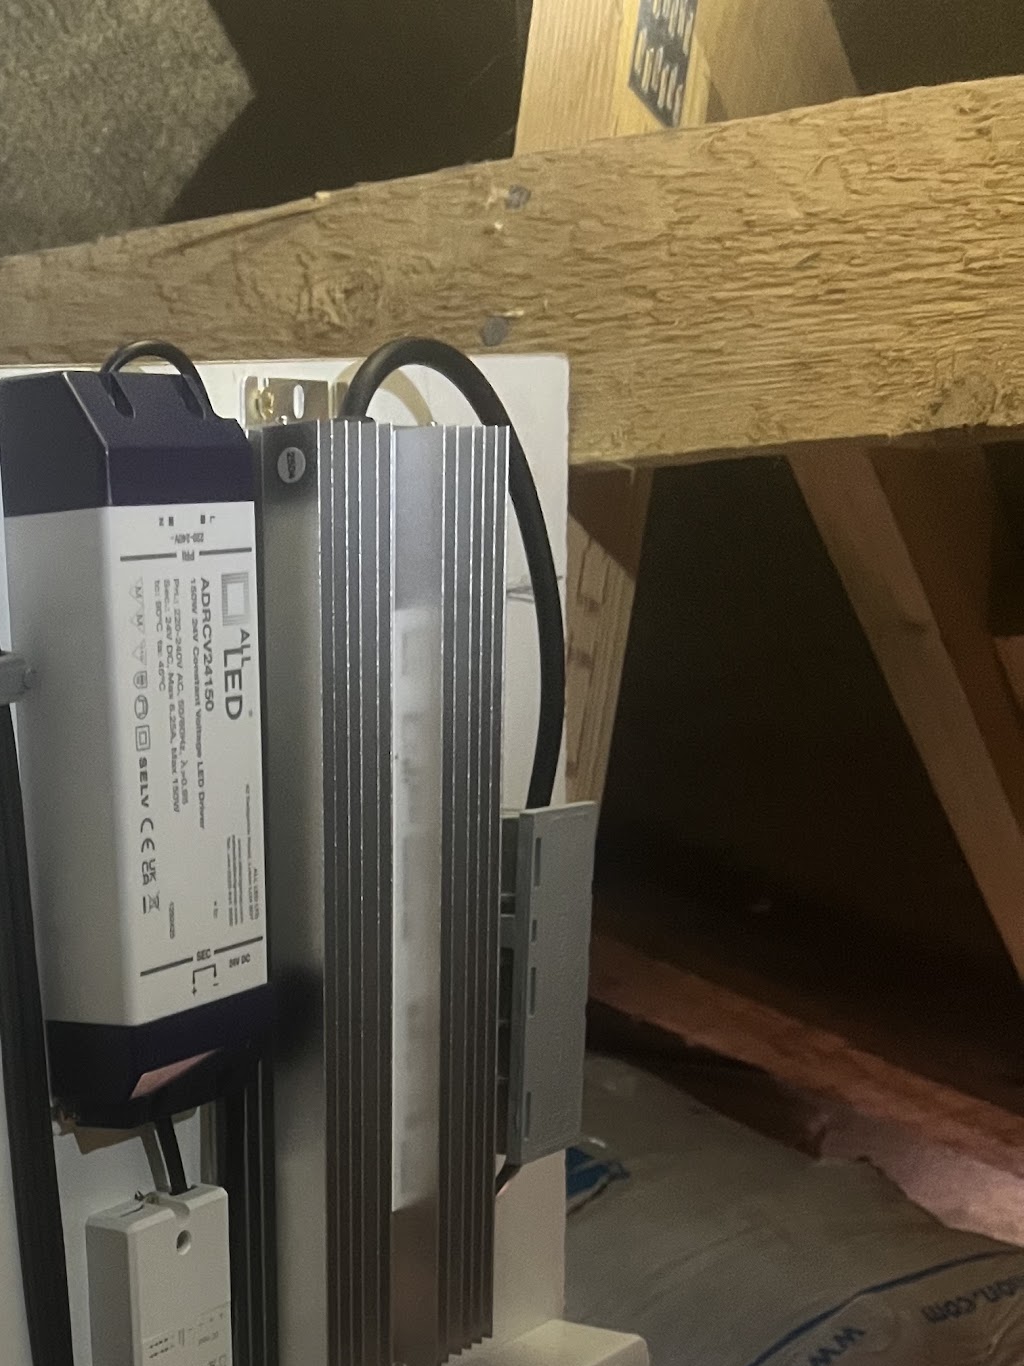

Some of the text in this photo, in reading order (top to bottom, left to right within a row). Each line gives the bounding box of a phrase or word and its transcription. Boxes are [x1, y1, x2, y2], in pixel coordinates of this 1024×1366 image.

[189, 577, 197, 614] 150W
[164, 615, 172, 640] 24V
[173, 607, 182, 668] 220-240V
[200, 576, 214, 712] ADRCV24150
[239, 628, 251, 667] ALL
[166, 672, 175, 700] Max
[192, 645, 201, 706] Constant
[223, 647, 244, 721] LED
[194, 708, 203, 758] Voltage
[169, 747, 178, 774] Max
[196, 760, 204, 788] LED
[138, 756, 148, 808] SELV
[171, 777, 179, 813] 150W
[197, 791, 205, 829] Driver
[196, 947, 211, 962] SEC
